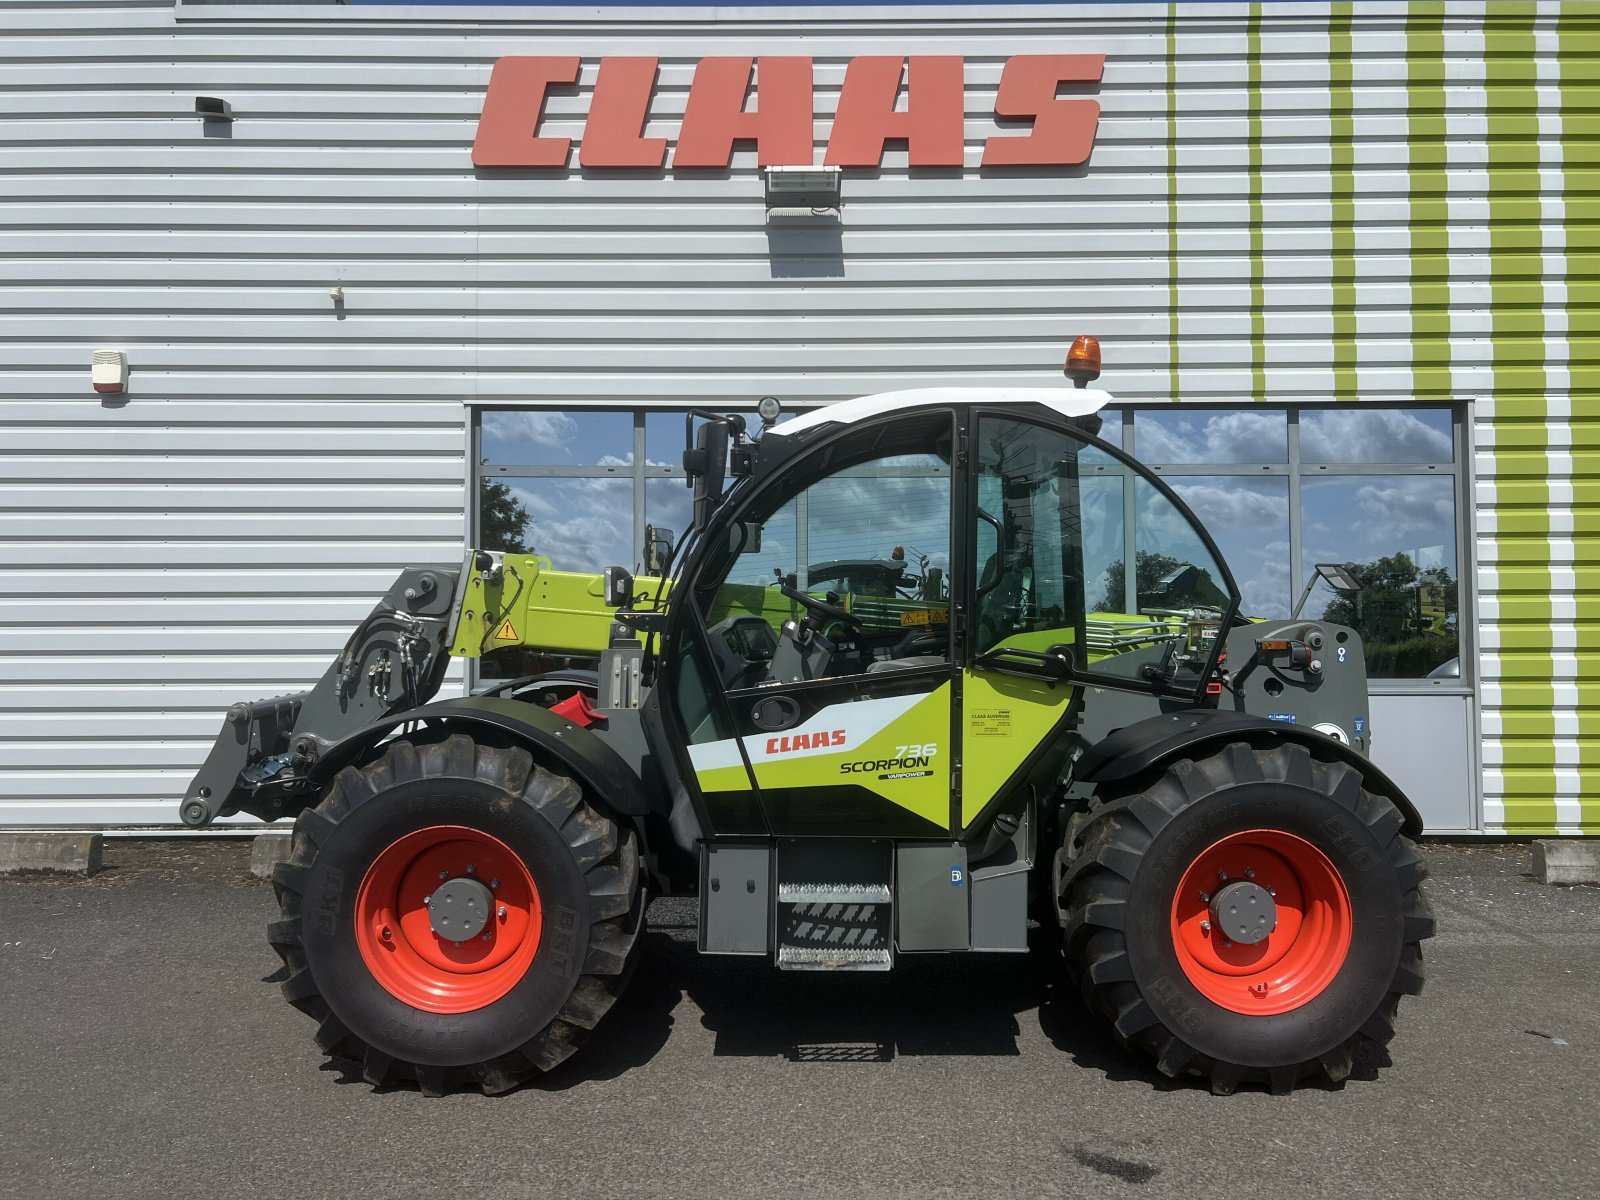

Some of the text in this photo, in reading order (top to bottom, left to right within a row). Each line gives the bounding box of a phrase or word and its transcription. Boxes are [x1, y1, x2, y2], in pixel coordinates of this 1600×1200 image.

[471, 54, 1106, 167] CLAAS
[766, 730, 845, 754] CLAAS
[895, 743, 937, 759] 736
[840, 756, 929, 774] SCORPION
[546, 904, 580, 977] BKT
